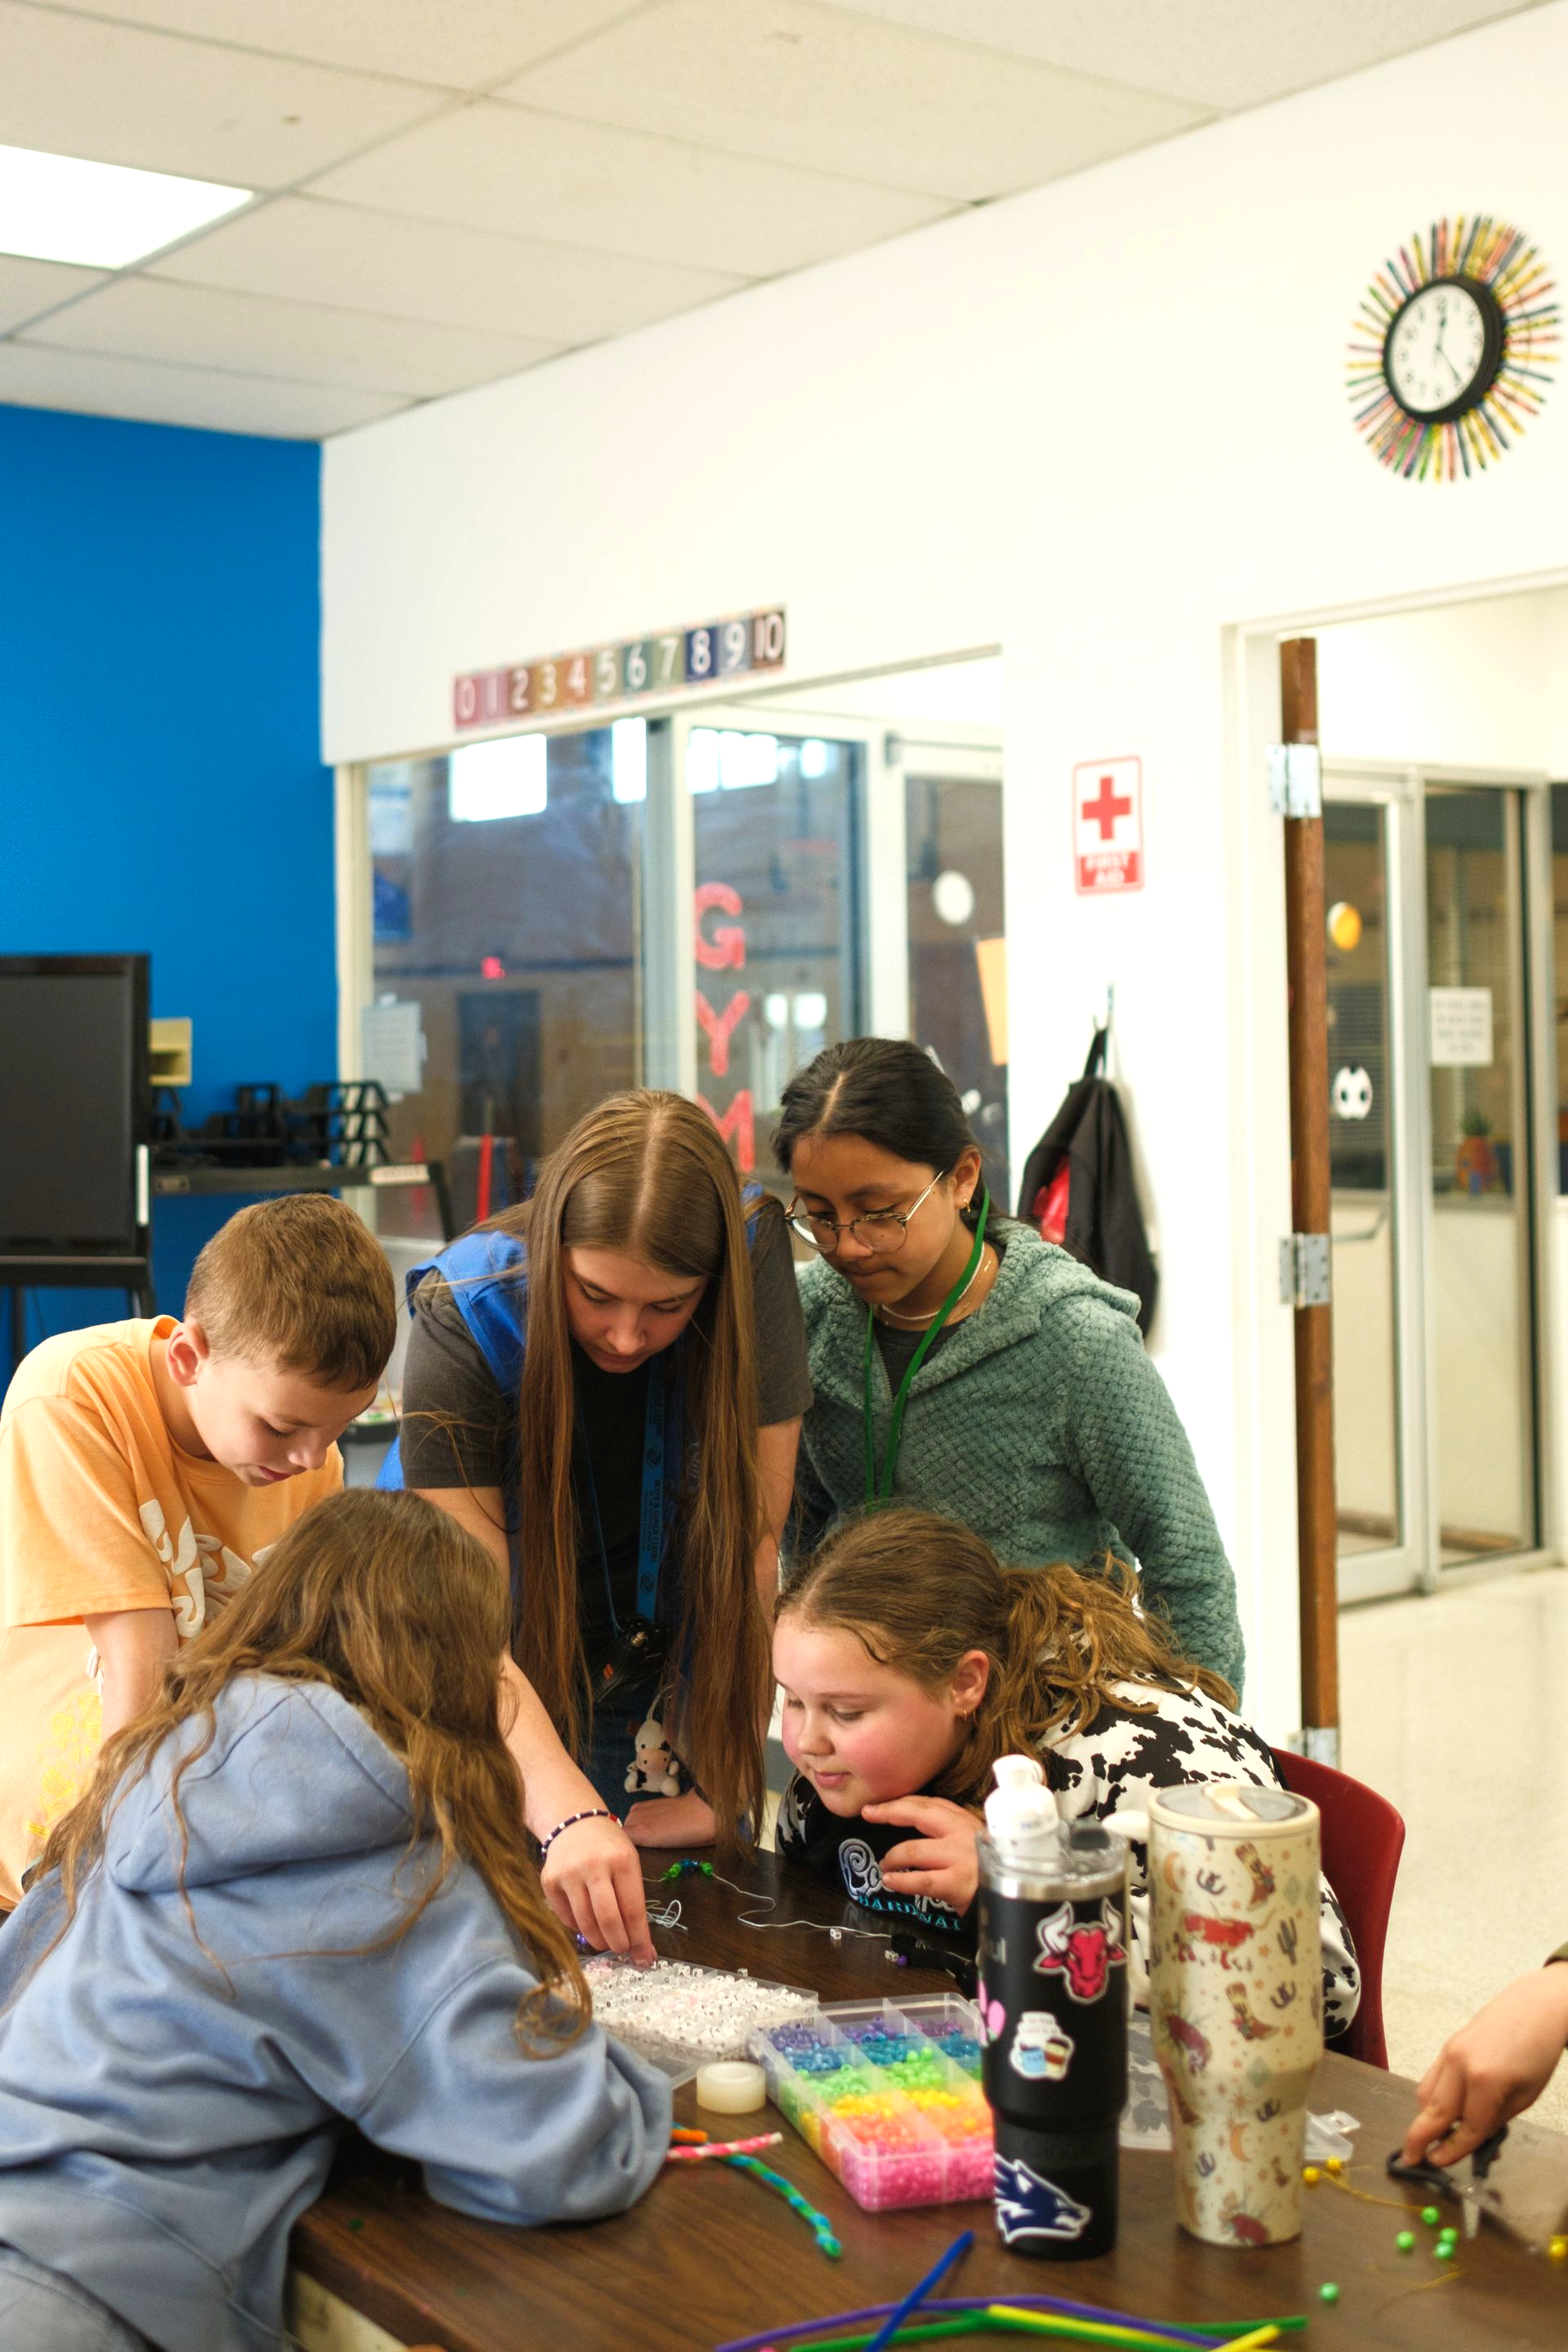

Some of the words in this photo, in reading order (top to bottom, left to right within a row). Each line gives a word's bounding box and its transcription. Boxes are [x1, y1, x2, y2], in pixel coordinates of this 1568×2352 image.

[458, 679, 476, 719] 0
[510, 668, 529, 709] 2
[540, 663, 557, 706] 3
[567, 656, 586, 697] 4
[597, 648, 617, 693] 5
[627, 644, 647, 688] 6
[657, 636, 679, 680] 7
[690, 629, 711, 674] 8
[724, 621, 746, 667] 9
[755, 612, 785, 660] 10
[694, 882, 755, 1173] GYM
